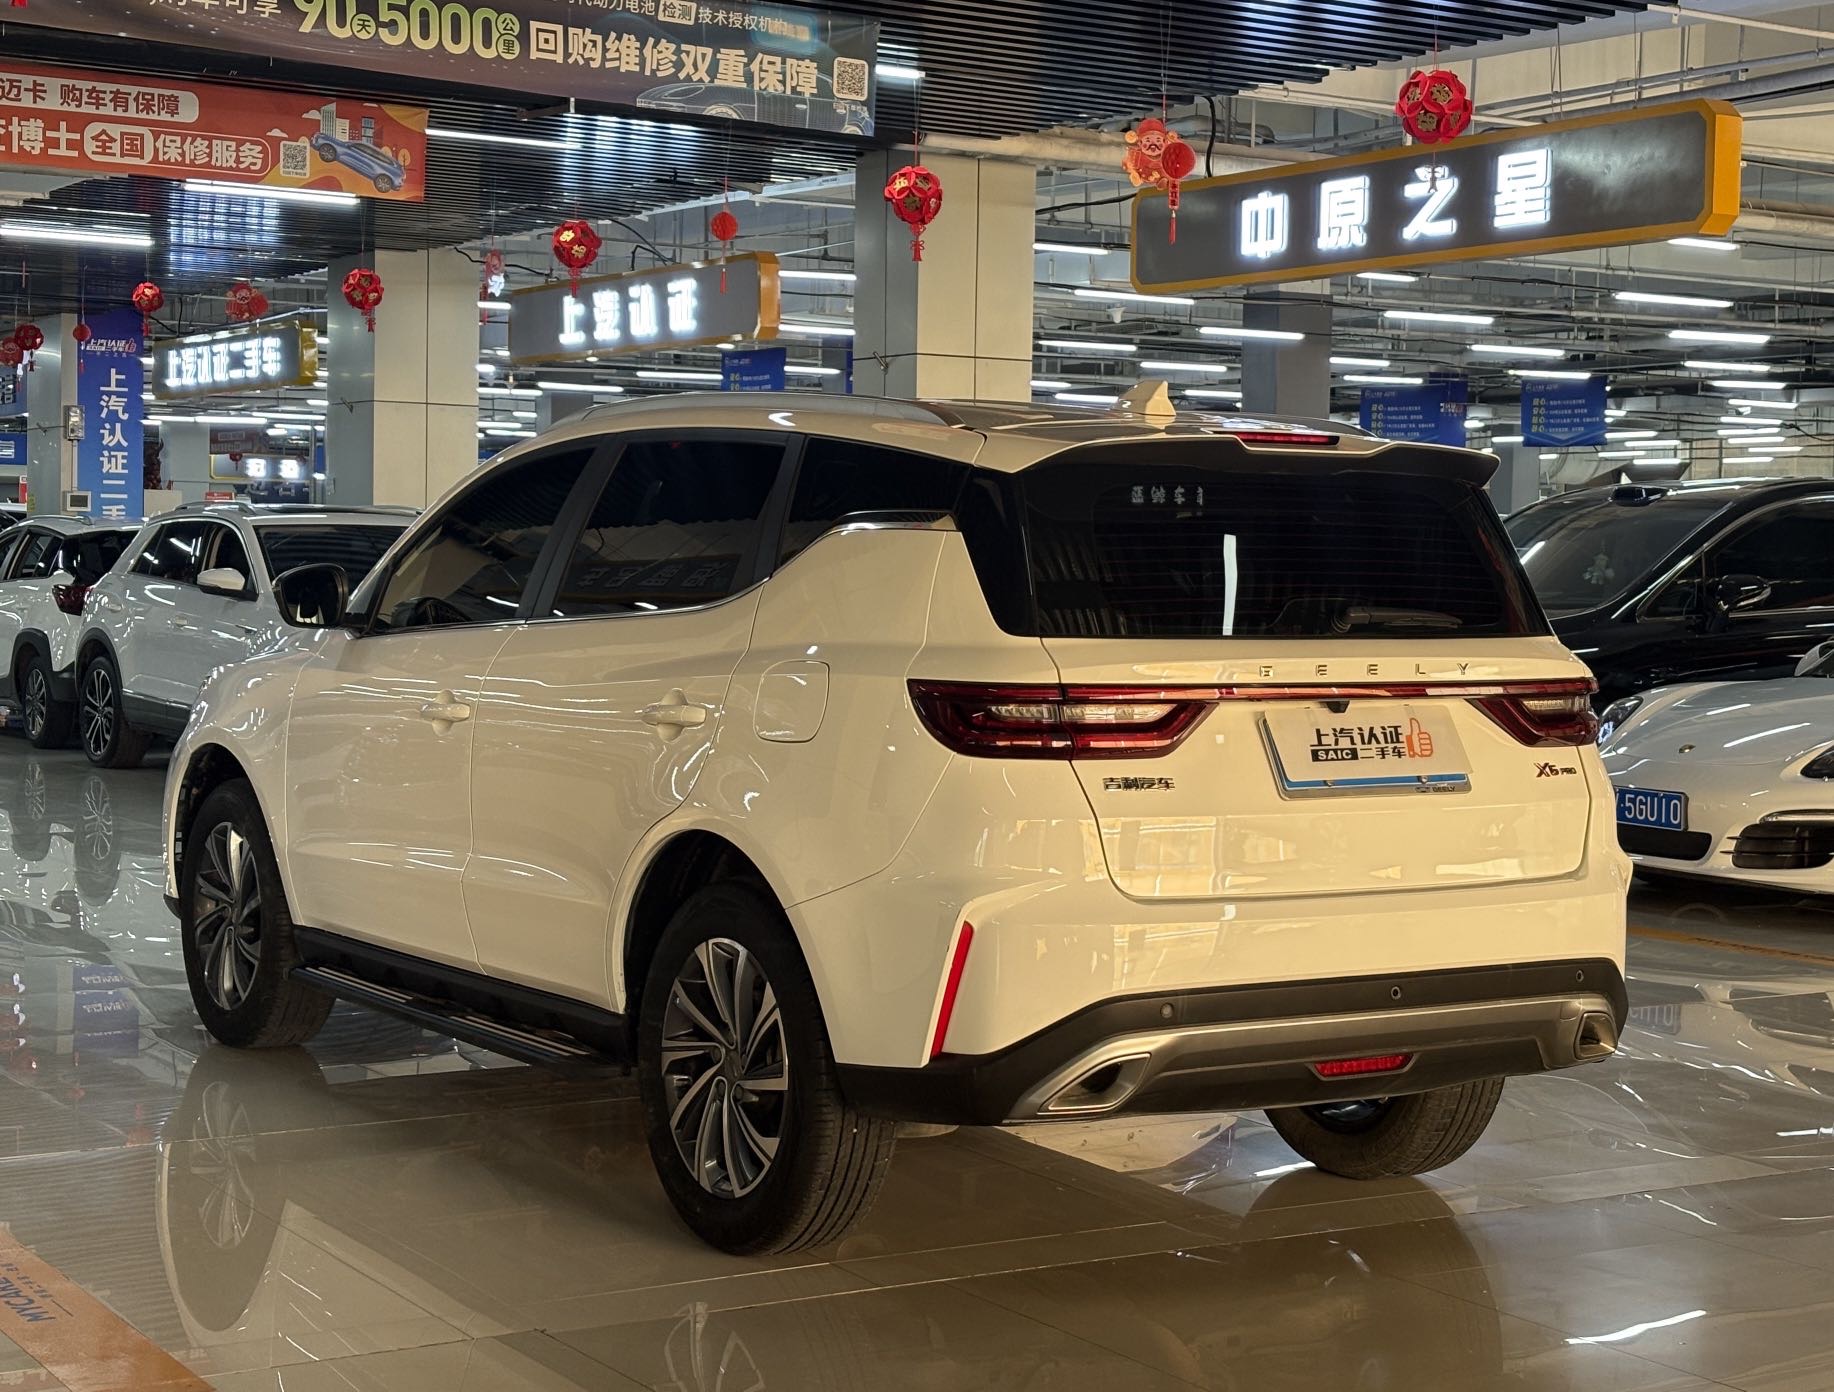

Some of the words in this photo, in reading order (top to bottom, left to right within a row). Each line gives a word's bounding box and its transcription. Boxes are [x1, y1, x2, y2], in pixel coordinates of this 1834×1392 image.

[662, 4, 692, 22] 检测
[529, 20, 819, 98] 回购维修双重保障
[0, 78, 48, 105] 迈卡
[60, 83, 181, 118] 购车有保障
[0, 116, 81, 158] 博士
[89, 127, 147, 161] 全国
[155, 137, 265, 171] 保修服务
[1240, 147, 1553, 260] 中原之星
[1259, 663, 1469, 677] GEELY
[1310, 725, 1405, 747] 上汽认证
[1317, 750, 1353, 761] SAIC
[1360, 745, 1406, 760] 二手车
